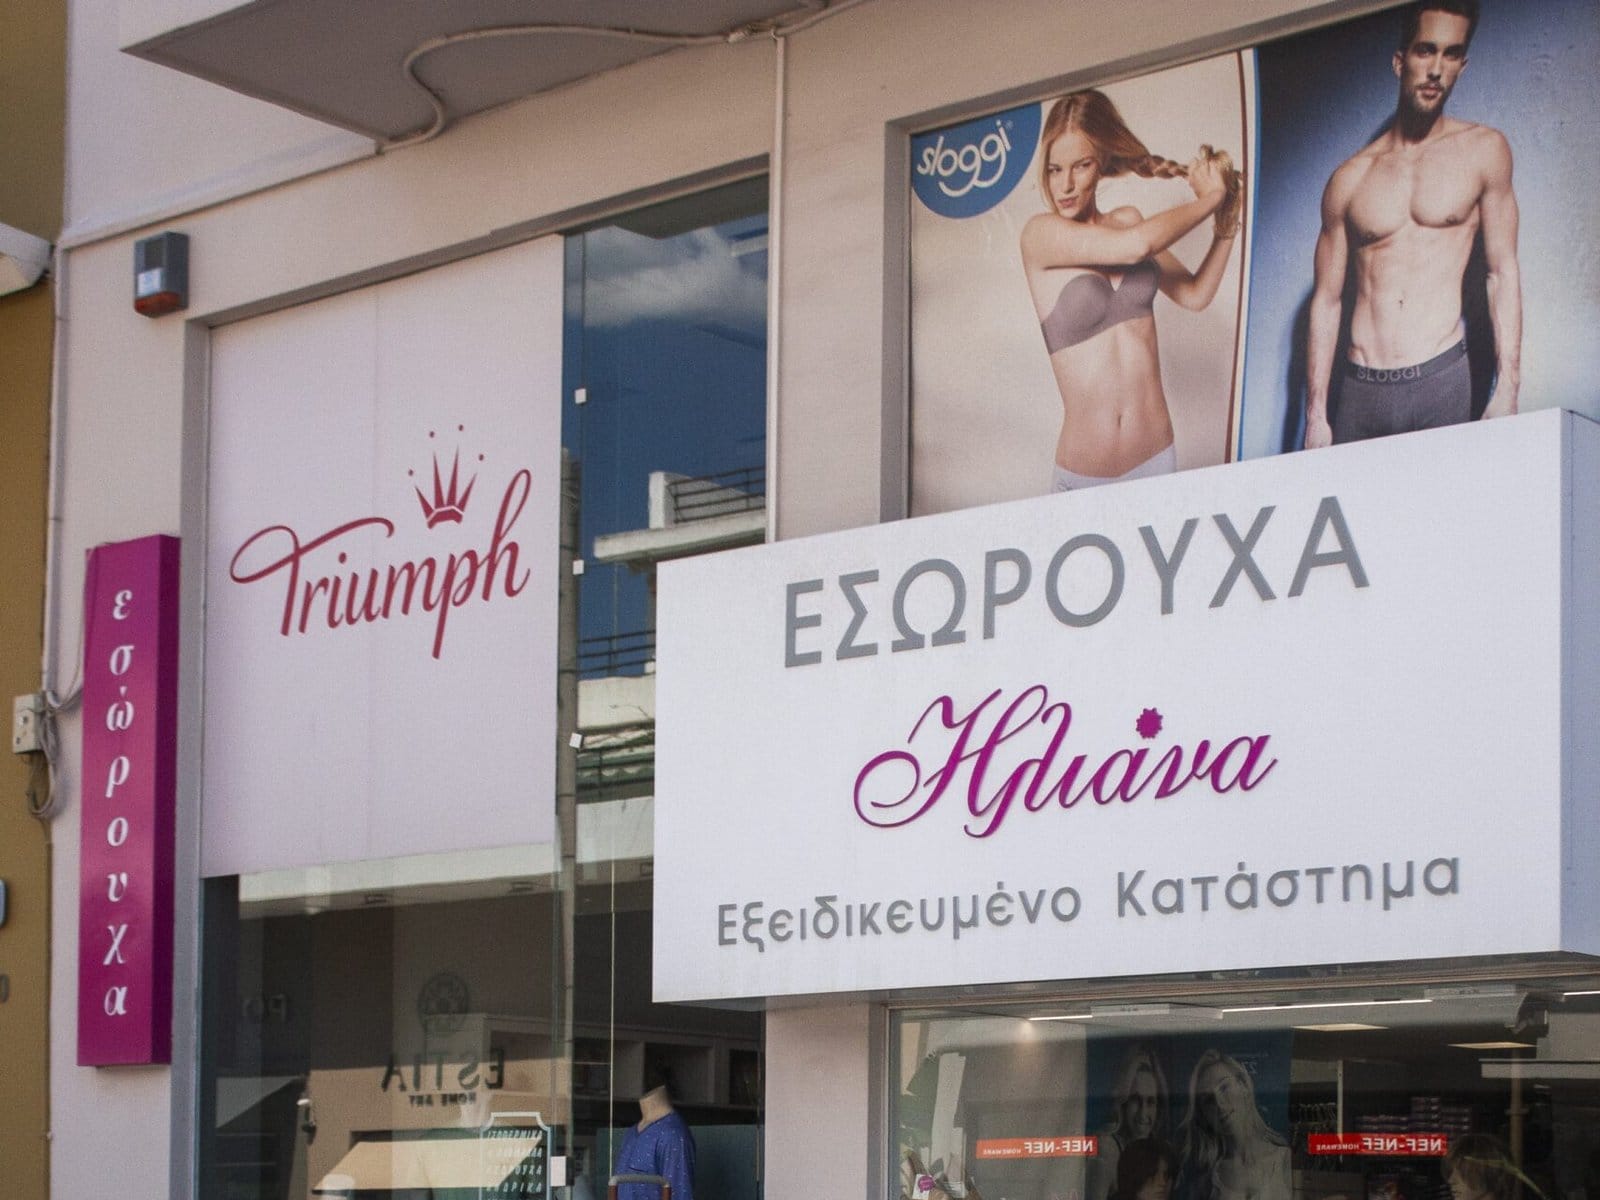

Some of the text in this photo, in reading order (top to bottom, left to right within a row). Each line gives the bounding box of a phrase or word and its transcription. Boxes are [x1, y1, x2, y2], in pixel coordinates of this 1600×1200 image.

[917, 119, 1012, 198] sloggi
[1357, 365, 1421, 382] SLOGGI
[230, 468, 530, 658] Triumph
[786, 496, 1370, 666] ΕΣΩΡΟΥΧΑ
[104, 590, 135, 1016] εσώρουχα
[718, 857, 1461, 953] Εξειδικευμένο Κατάστημα
